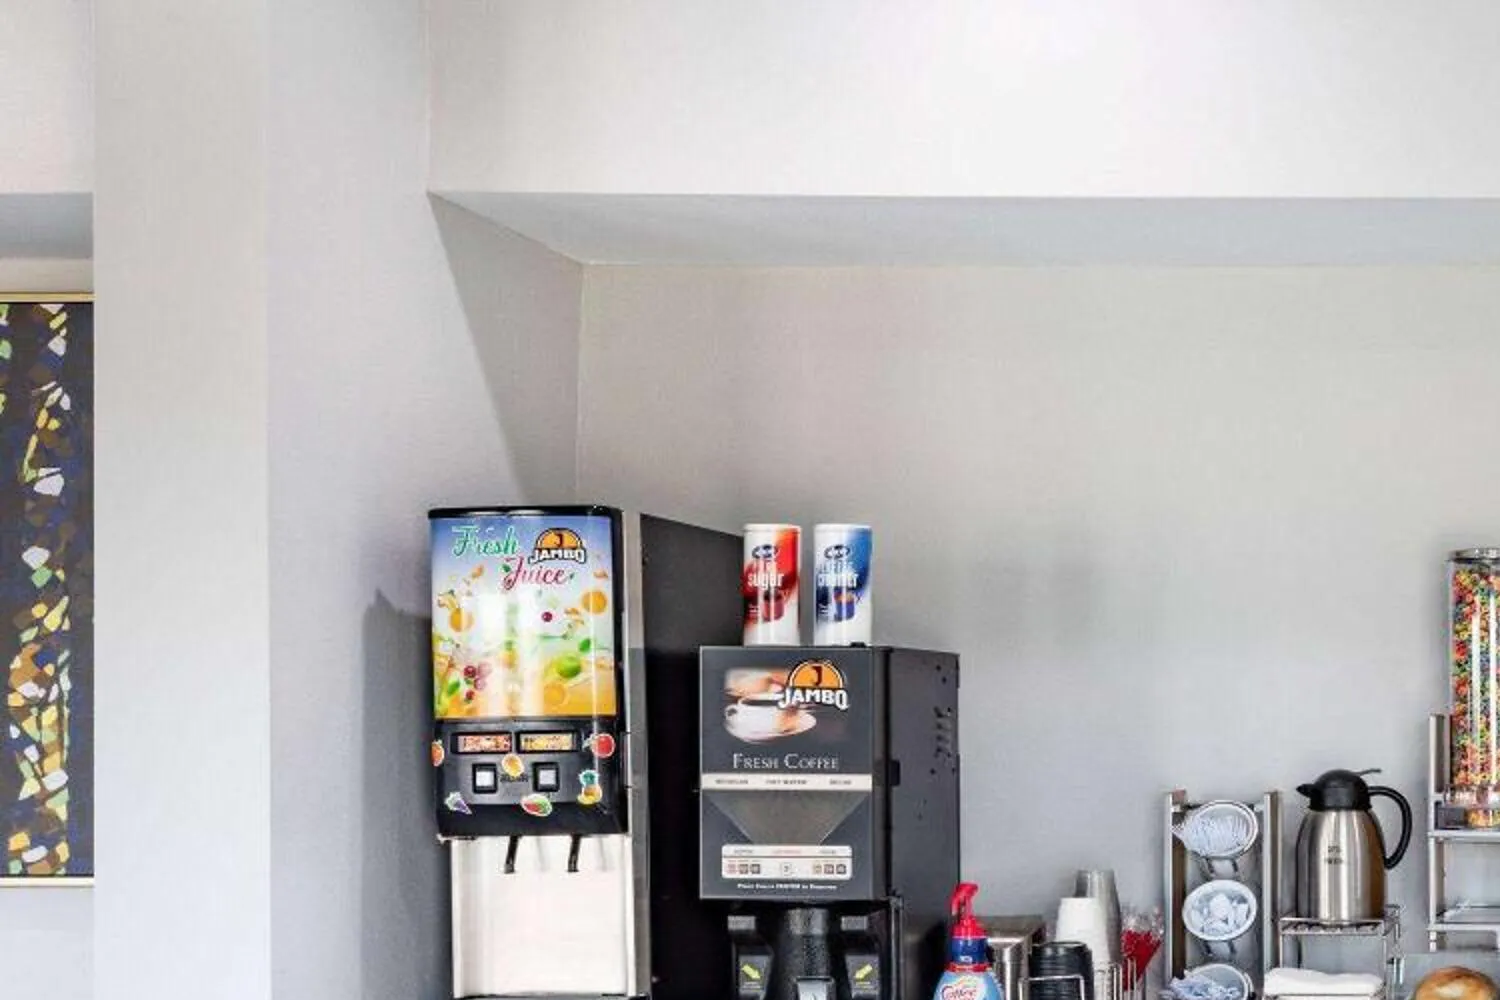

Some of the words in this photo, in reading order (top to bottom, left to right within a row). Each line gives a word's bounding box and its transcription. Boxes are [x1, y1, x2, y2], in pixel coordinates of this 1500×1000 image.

[453, 525, 519, 556] Fresh
[529, 549, 585, 563] JAMBO
[502, 556, 565, 590] Juice
[747, 573, 784, 590] sugar
[777, 688, 849, 710] JAMBO
[733, 753, 778, 769] FRESH
[784, 753, 839, 769] COFFEE
